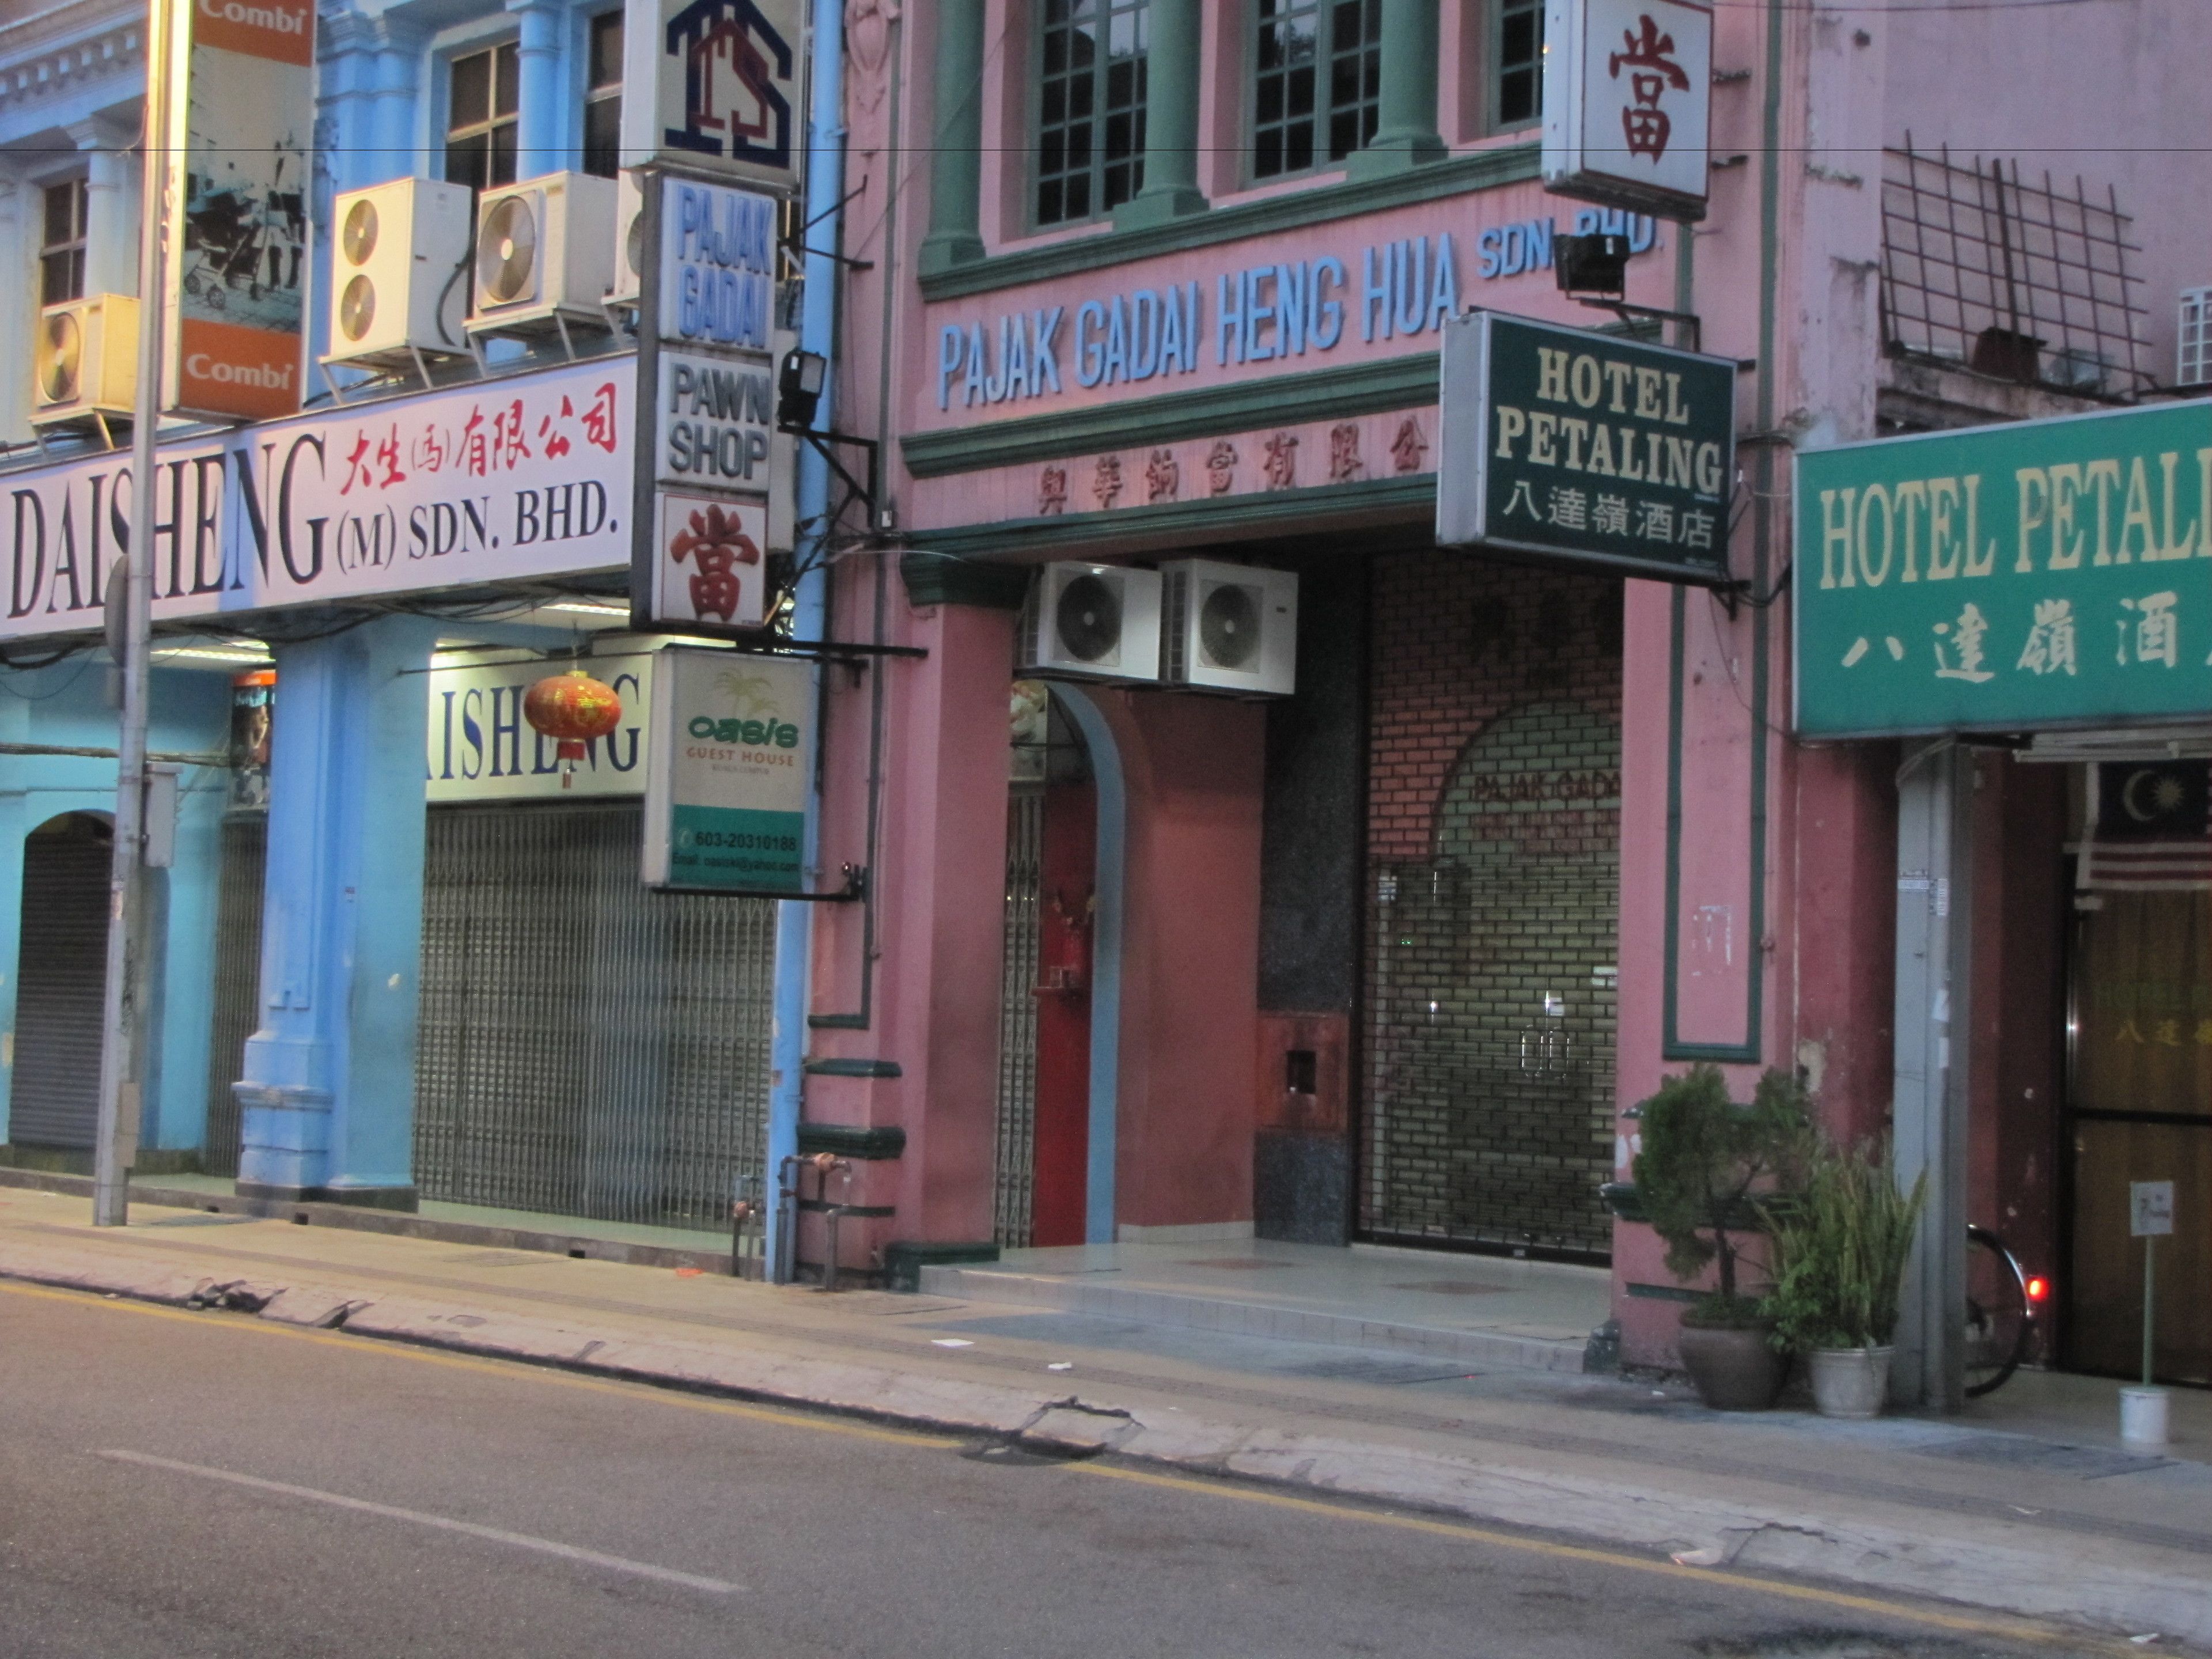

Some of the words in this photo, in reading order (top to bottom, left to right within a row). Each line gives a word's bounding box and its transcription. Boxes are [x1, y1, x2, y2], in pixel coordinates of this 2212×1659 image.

[200, 0, 308, 35] Combi
[1609, 14, 1690, 165] 當
[938, 305, 1064, 411] PAJAK
[1074, 280, 1198, 388] GADAI
[1217, 255, 1343, 366] HENG
[1361, 233, 1459, 342] HUA
[186, 353, 293, 390] Combi
[669, 362, 770, 425] PAWN
[1537, 347, 1690, 426] HOTEL
[669, 420, 767, 480] SHOP
[1495, 404, 1724, 495] PETALING
[337, 504, 396, 575] (M)
[408, 495, 499, 560] SDN.
[513, 479, 618, 546] BHD.
[1502, 480, 1716, 550] 八達嶺酒店
[1819, 474, 1996, 590] HOTEL
[2014, 447, 2212, 573] PETALI
[670, 503, 760, 622] 當
[1841, 591, 2212, 683] 八達嶺酒
[426, 673, 642, 780] ISHG
[685, 747, 734, 762] GUEST
[741, 750, 794, 766] HOUSE
[695, 831, 797, 852] 603-20310188
